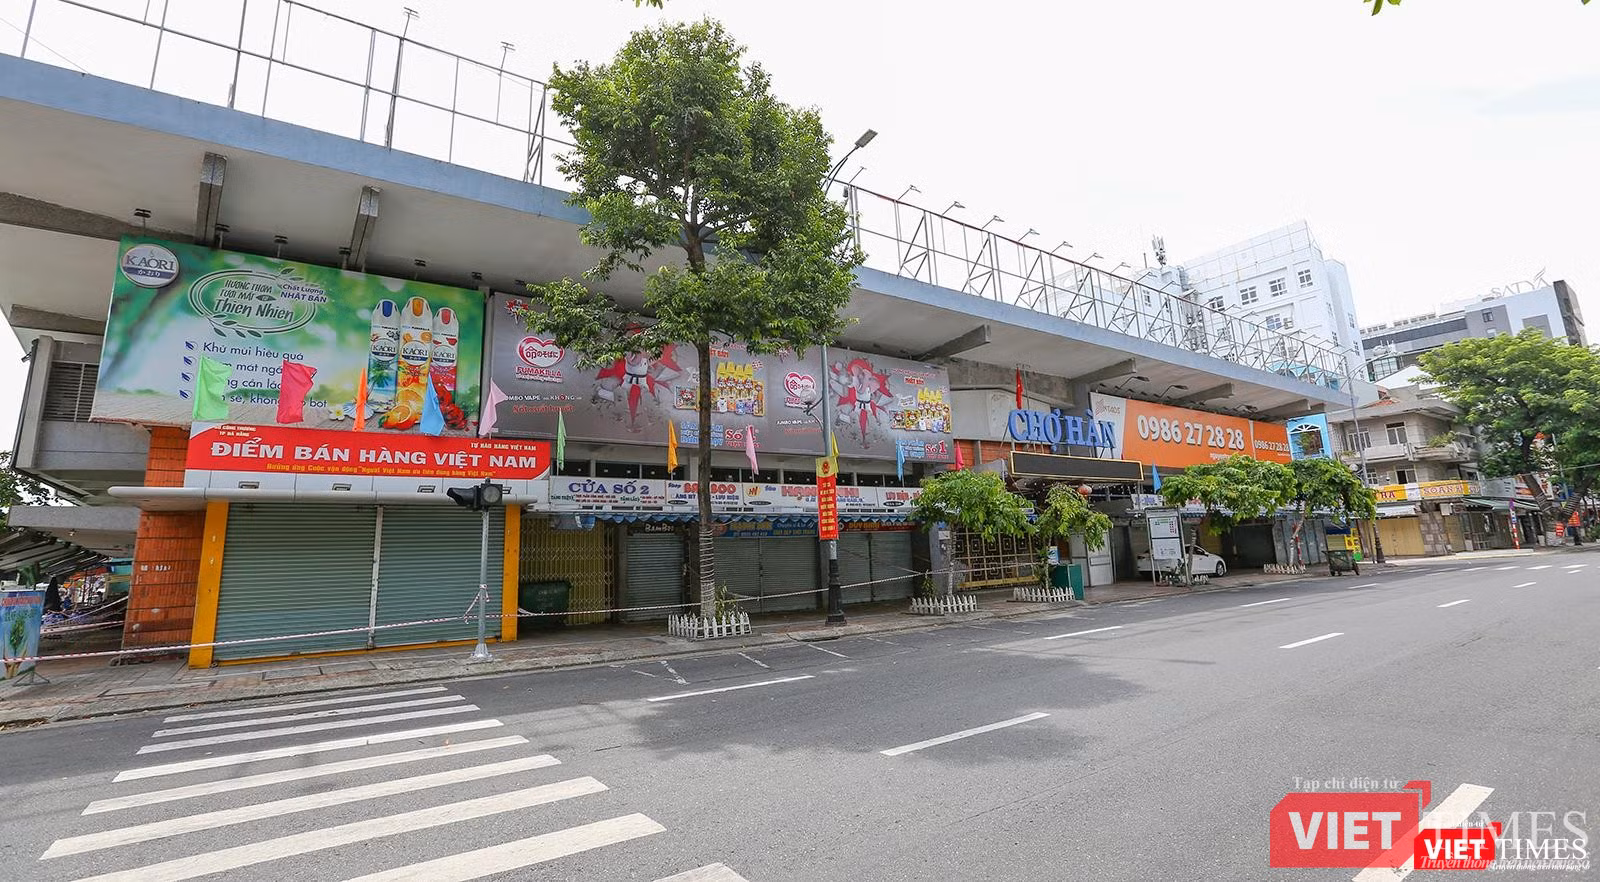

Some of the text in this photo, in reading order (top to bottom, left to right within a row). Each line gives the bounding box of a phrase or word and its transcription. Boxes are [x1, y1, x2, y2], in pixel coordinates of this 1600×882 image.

[126, 255, 175, 271] KAORI
[203, 342, 226, 354] Khử
[230, 346, 252, 356] mùi
[255, 346, 280, 359] hiệu
[372, 345, 396, 353] KAORI
[402, 348, 428, 356] KAORI
[516, 366, 563, 376] FUMAKILLA
[725, 427, 744, 441] Số
[1008, 408, 1116, 453] CHỢ HÀN
[1137, 415, 1246, 451] 0986 27 28 28
[210, 437, 537, 469] ĐIỂM BÁN HÀNG VIỆT NAM
[1254, 439, 1269, 451] 0986
[568, 479, 650, 495] CỬA SỐ 2
